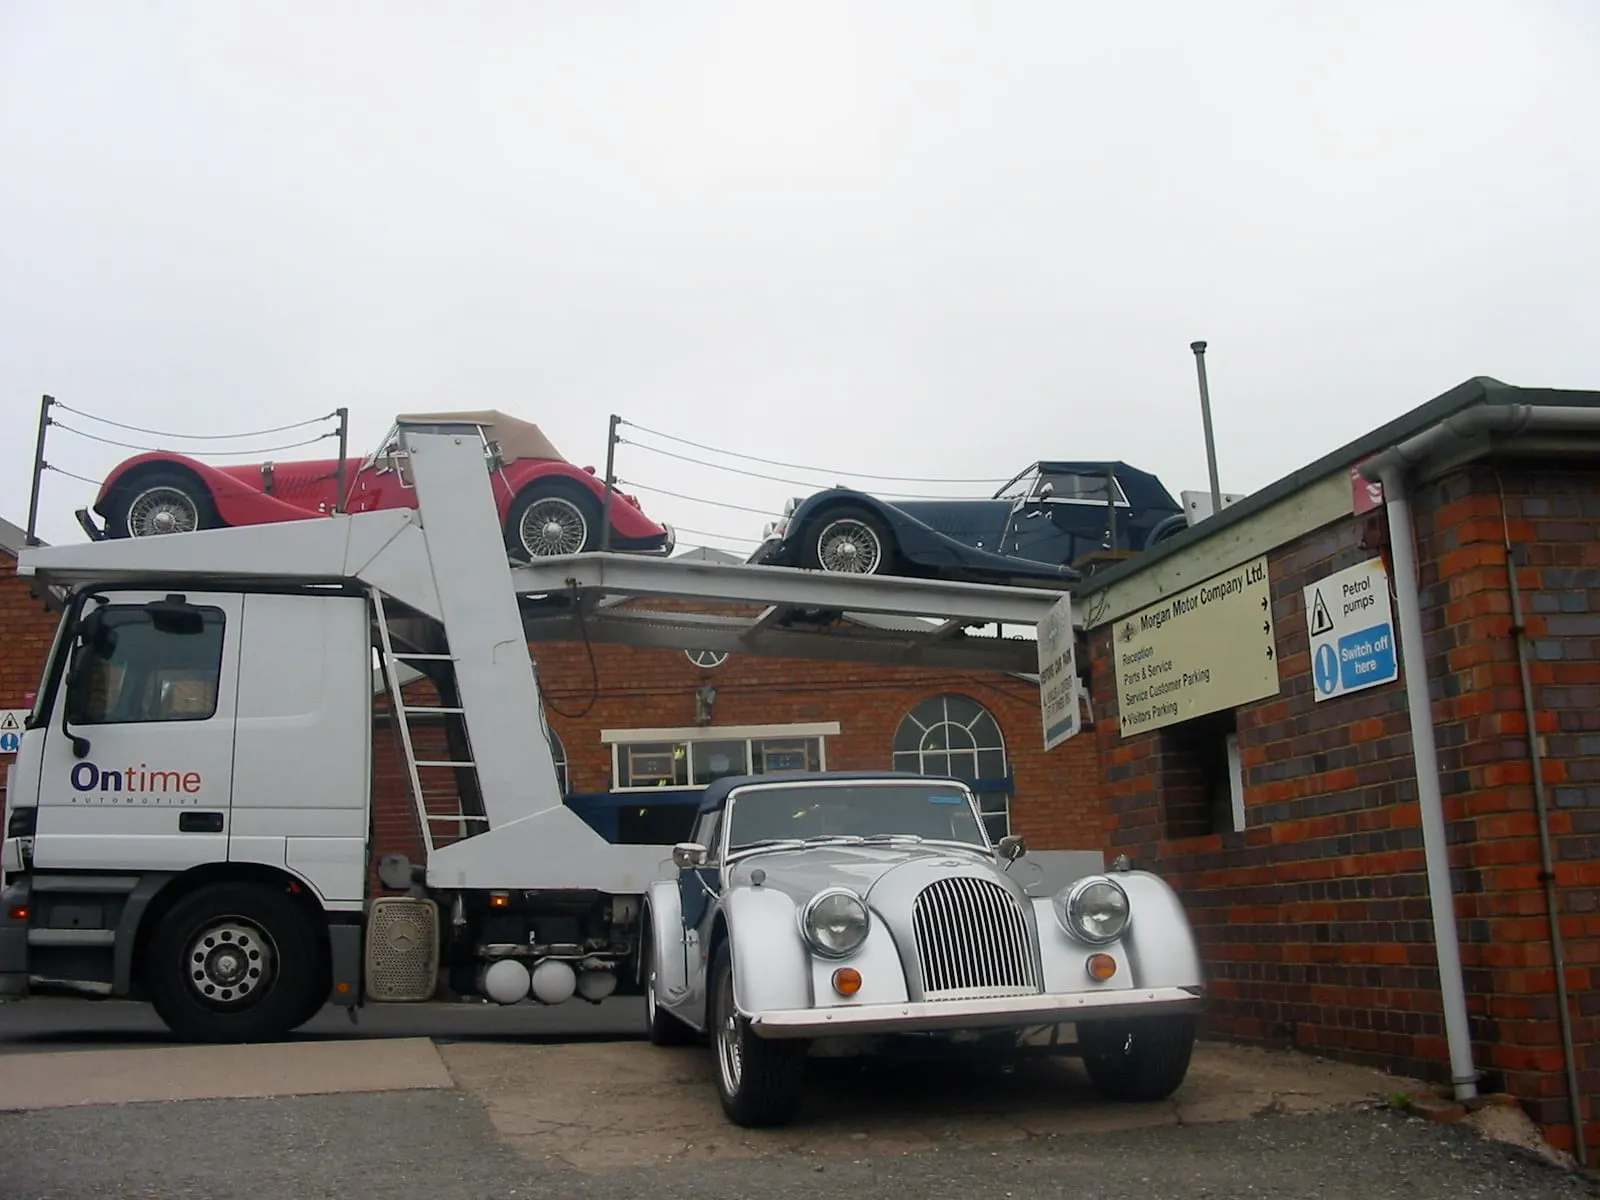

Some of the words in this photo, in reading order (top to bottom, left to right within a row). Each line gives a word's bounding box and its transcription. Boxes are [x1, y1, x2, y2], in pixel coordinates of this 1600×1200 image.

[1140, 608, 1171, 631] Morgan
[1172, 595, 1198, 618] Motor
[1200, 575, 1243, 605] Company
[1245, 563, 1266, 586] Ltd.
[1342, 575, 1371, 598] Petrol
[1343, 594, 1375, 617] pumps
[1122, 646, 1154, 665] Reception
[1341, 641, 1373, 662] Switch
[1374, 635, 1388, 652] off
[1124, 672, 1141, 685] Parts
[1147, 660, 1173, 677] Service
[1354, 659, 1377, 674] here
[1125, 690, 1149, 706] Service
[1149, 678, 1181, 698] Customer
[1183, 668, 1210, 687] Parking
[1127, 710, 1152, 725] Visitors
[1152, 702, 1178, 718] Parking
[70, 761, 201, 793] Ontime
